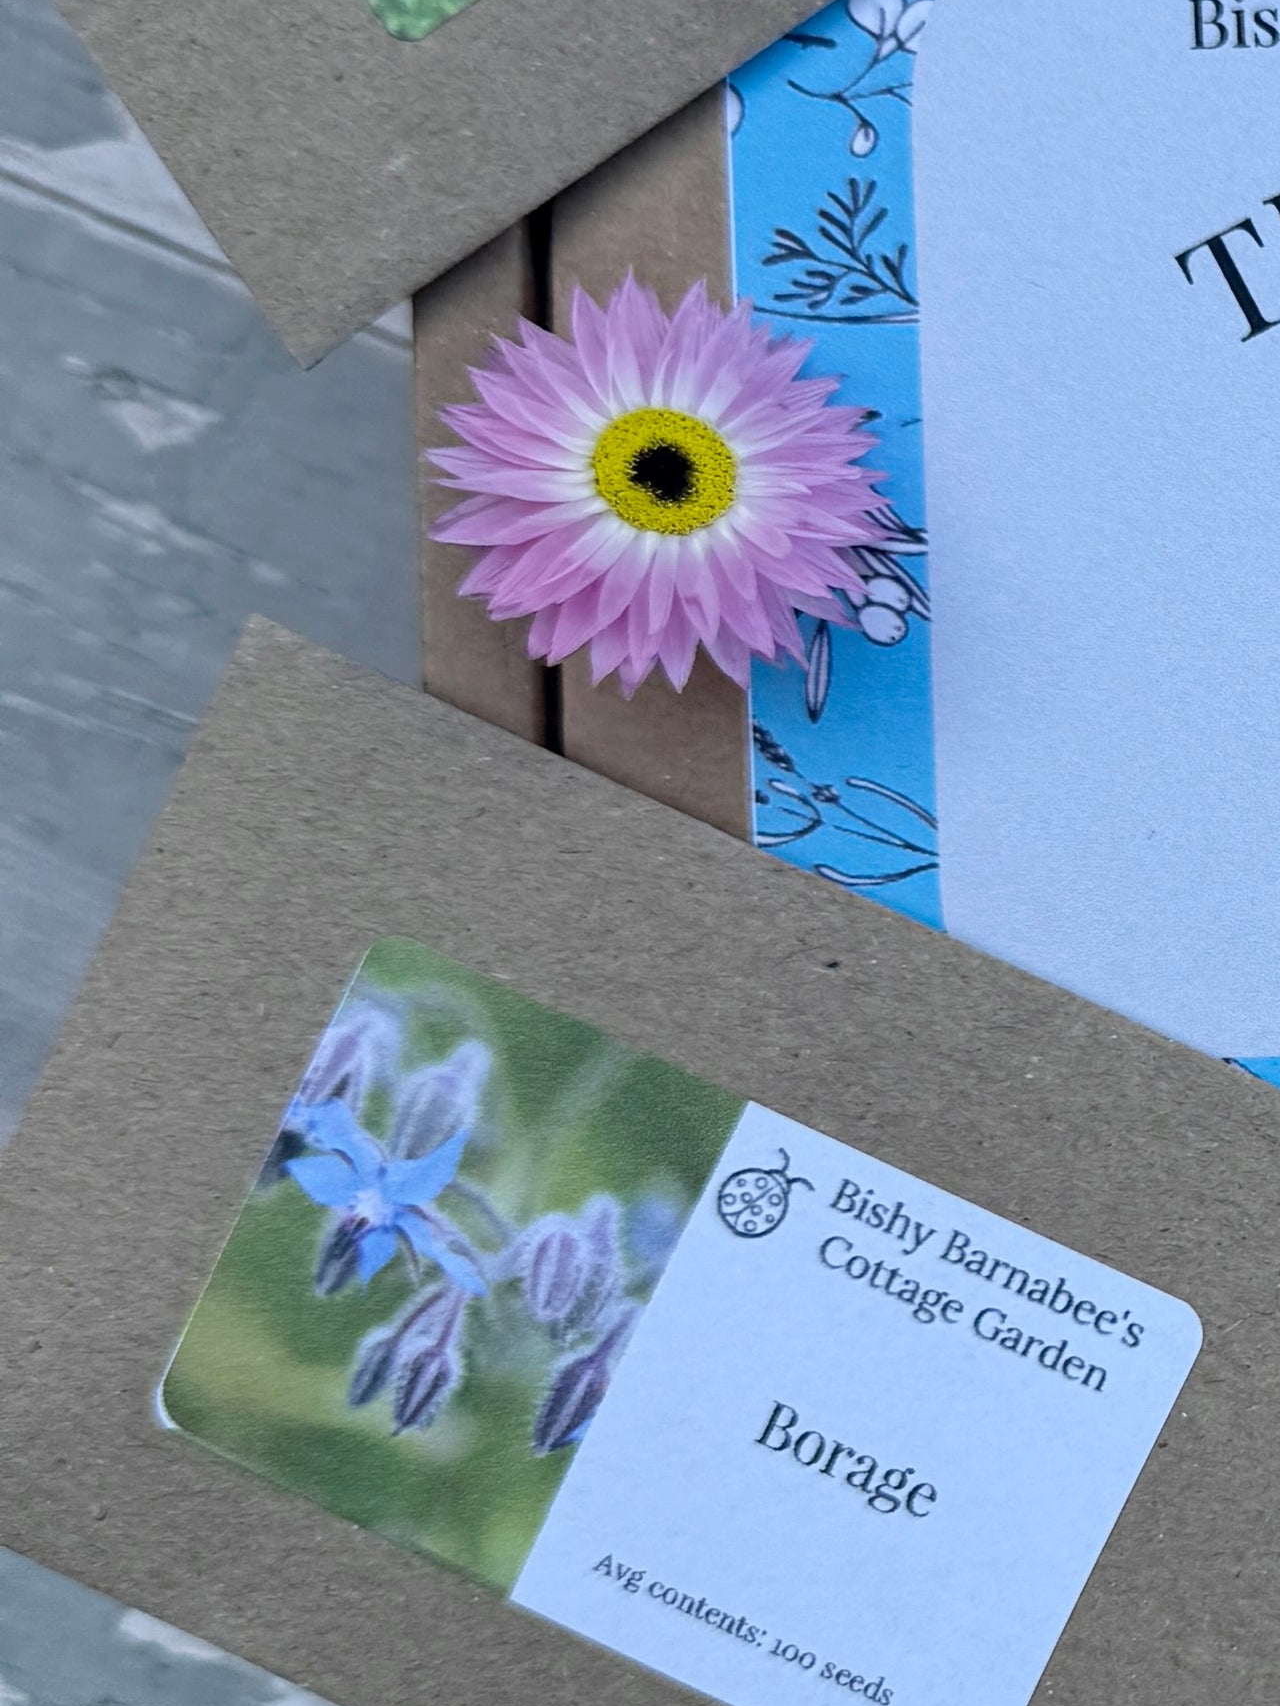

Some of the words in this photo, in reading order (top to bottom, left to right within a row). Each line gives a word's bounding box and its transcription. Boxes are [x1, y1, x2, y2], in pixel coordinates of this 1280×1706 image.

[819, 1235, 964, 1324] Cottage
[973, 1305, 1108, 1392] Garden
[829, 1179, 939, 1254] Bishy
[941, 1229, 1144, 1348] Barnabee's
[754, 1400, 939, 1519] Borage
[592, 1552, 646, 1593] Avg
[649, 1577, 768, 1647] contents:
[770, 1639, 816, 1671] 100
[820, 1659, 894, 1706] seeds
